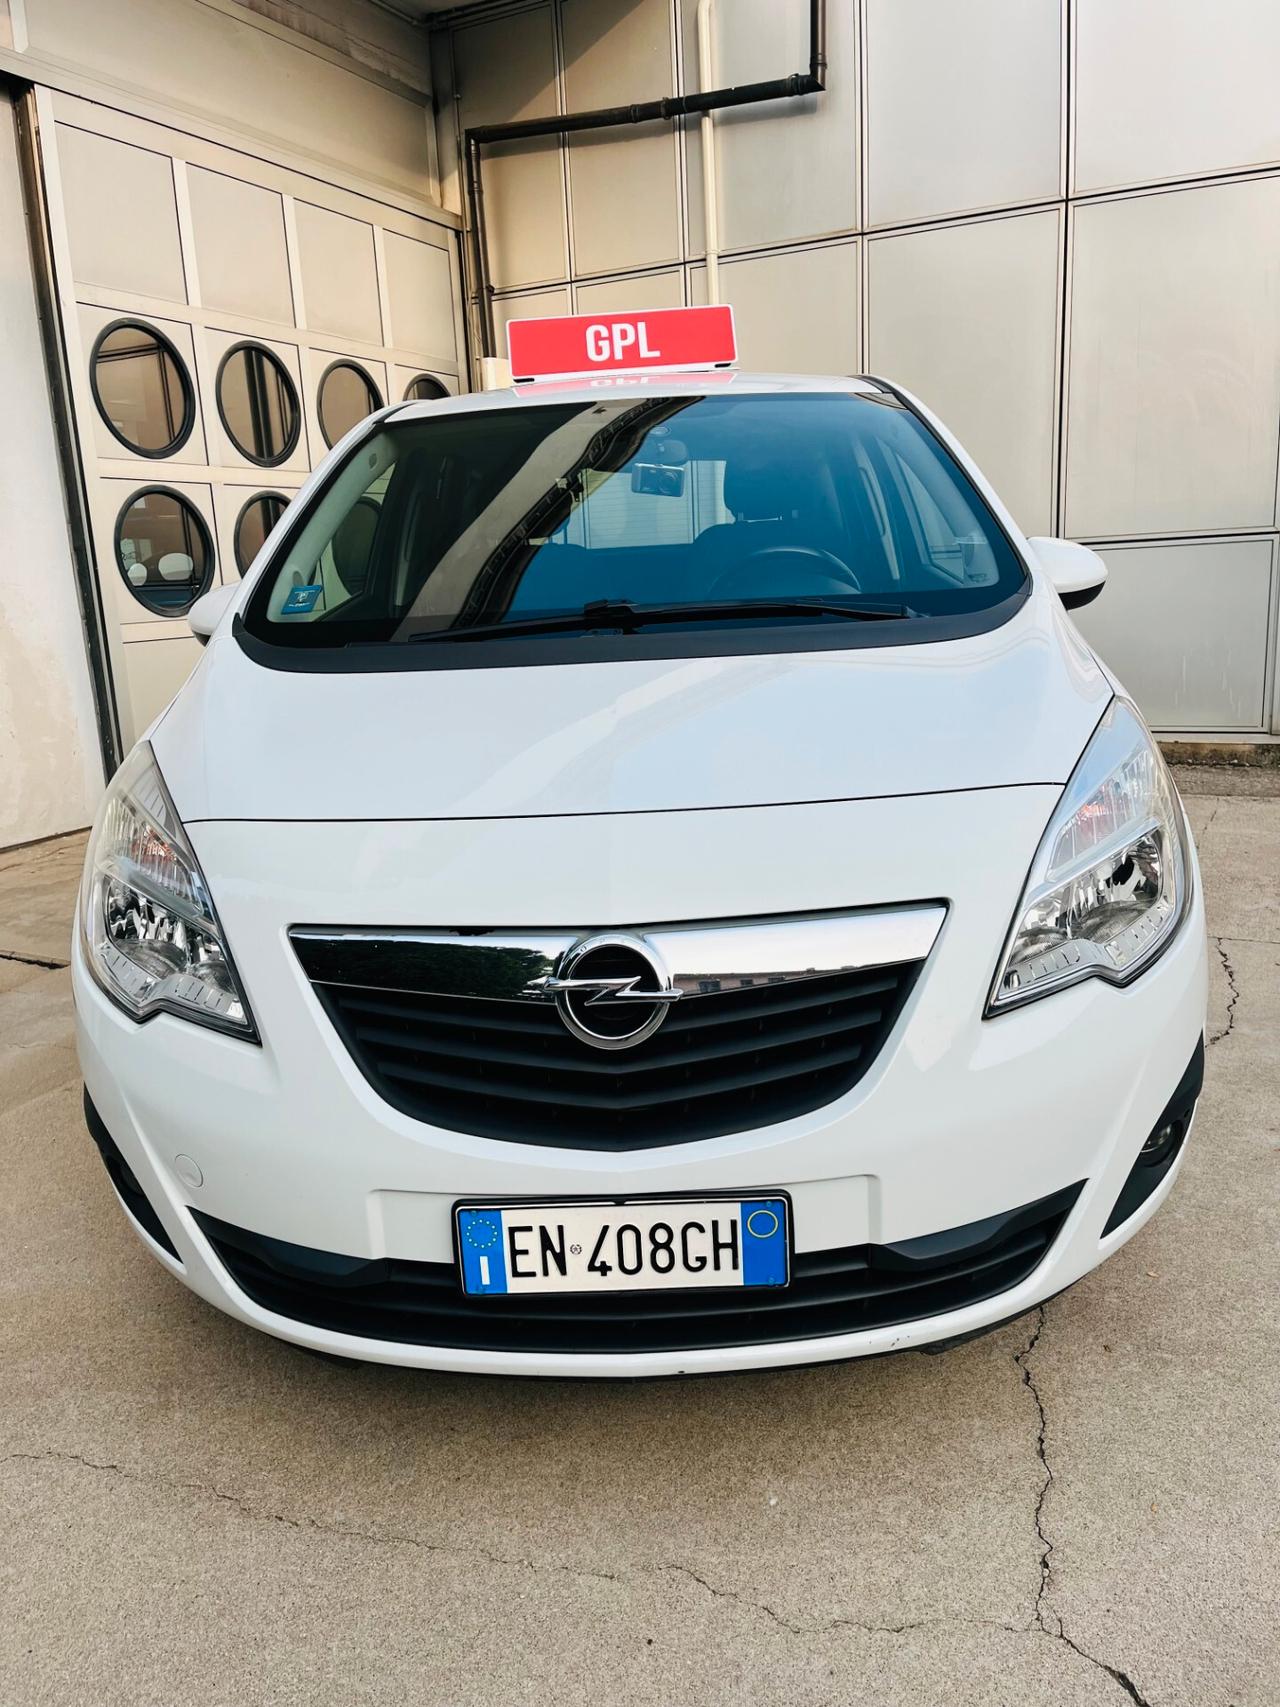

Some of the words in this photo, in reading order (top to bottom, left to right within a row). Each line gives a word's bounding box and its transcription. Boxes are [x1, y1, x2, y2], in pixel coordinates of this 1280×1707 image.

[585, 321, 661, 362] GPL
[507, 1224, 568, 1278] EN
[587, 1219, 739, 1277] 408GH
[479, 1256, 490, 1285] I
